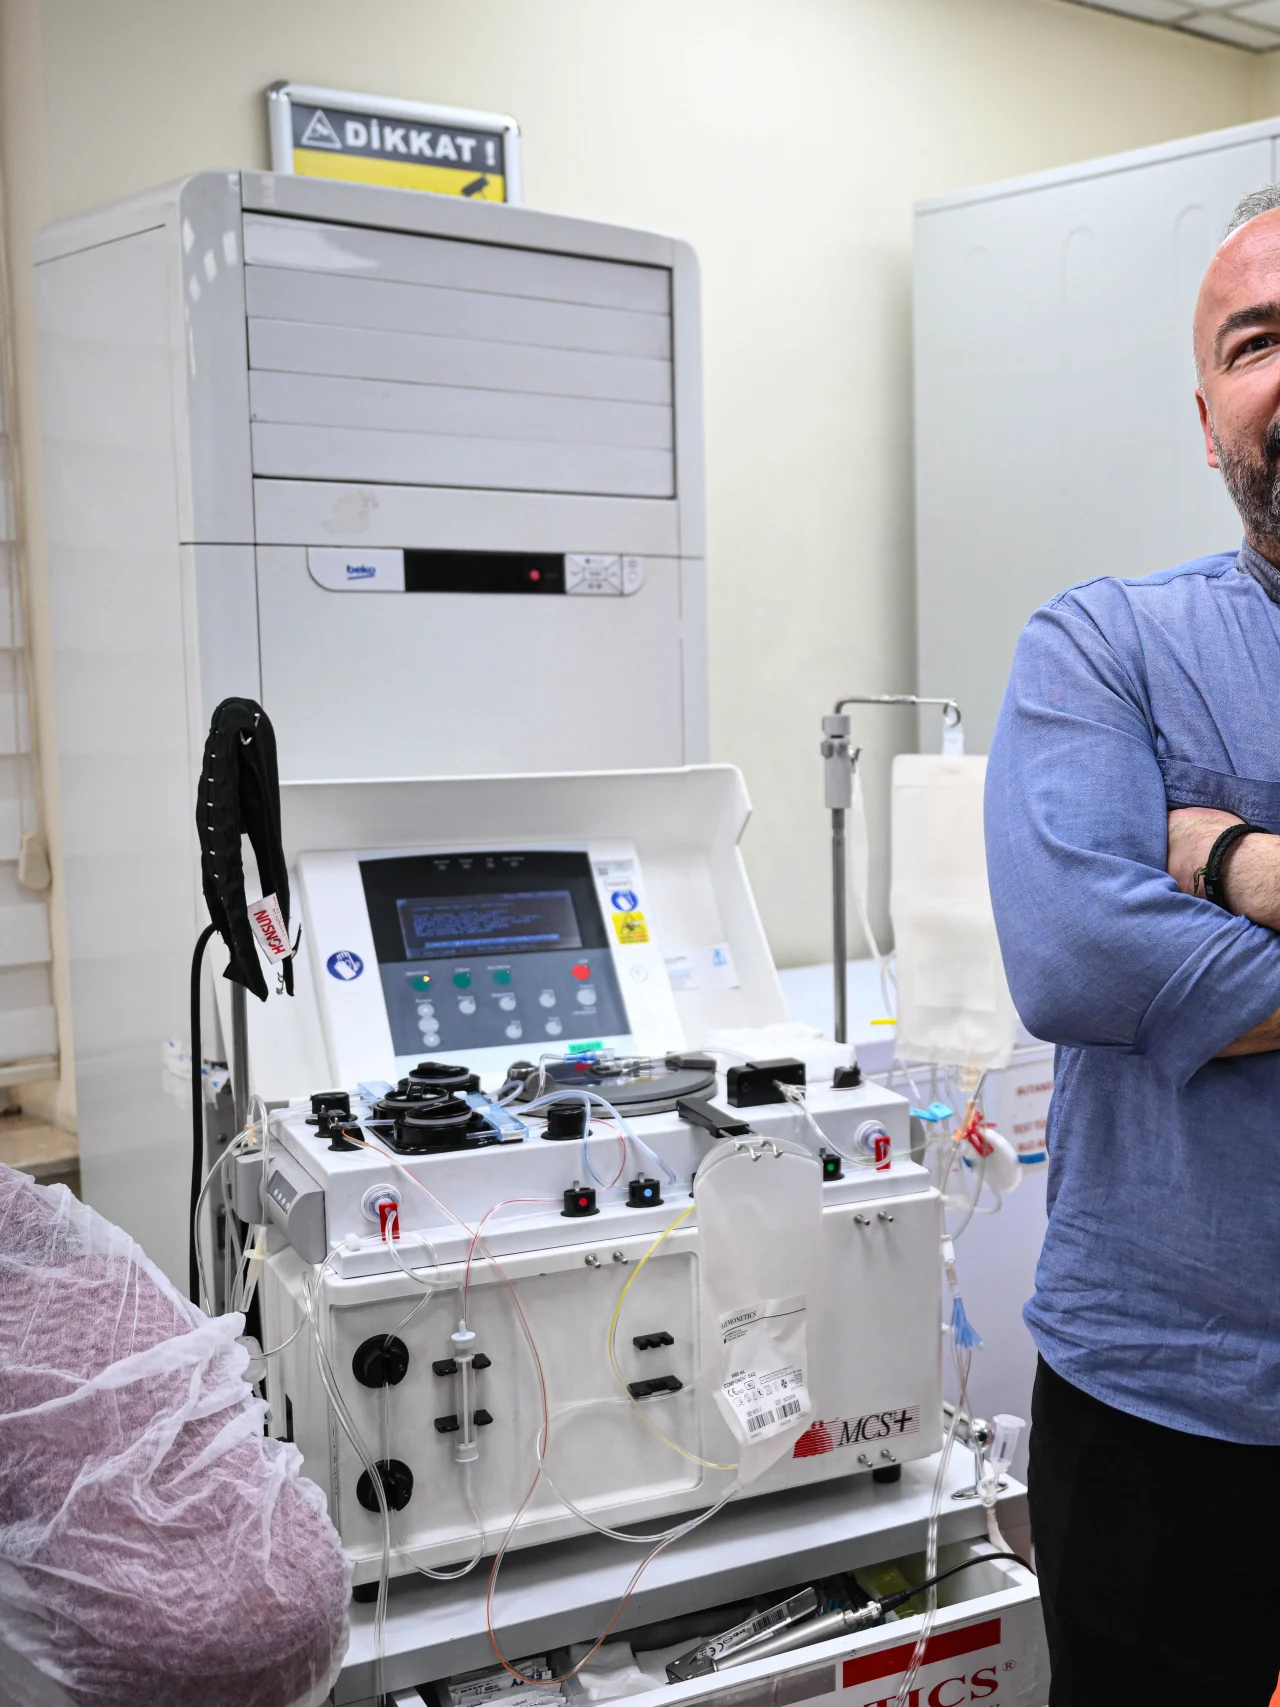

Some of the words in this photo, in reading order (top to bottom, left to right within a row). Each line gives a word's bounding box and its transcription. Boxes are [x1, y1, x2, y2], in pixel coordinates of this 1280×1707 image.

[345, 117, 477, 163] DİKKAT
[346, 564, 376, 577] beko
[253, 909, 286, 955] HONSUN
